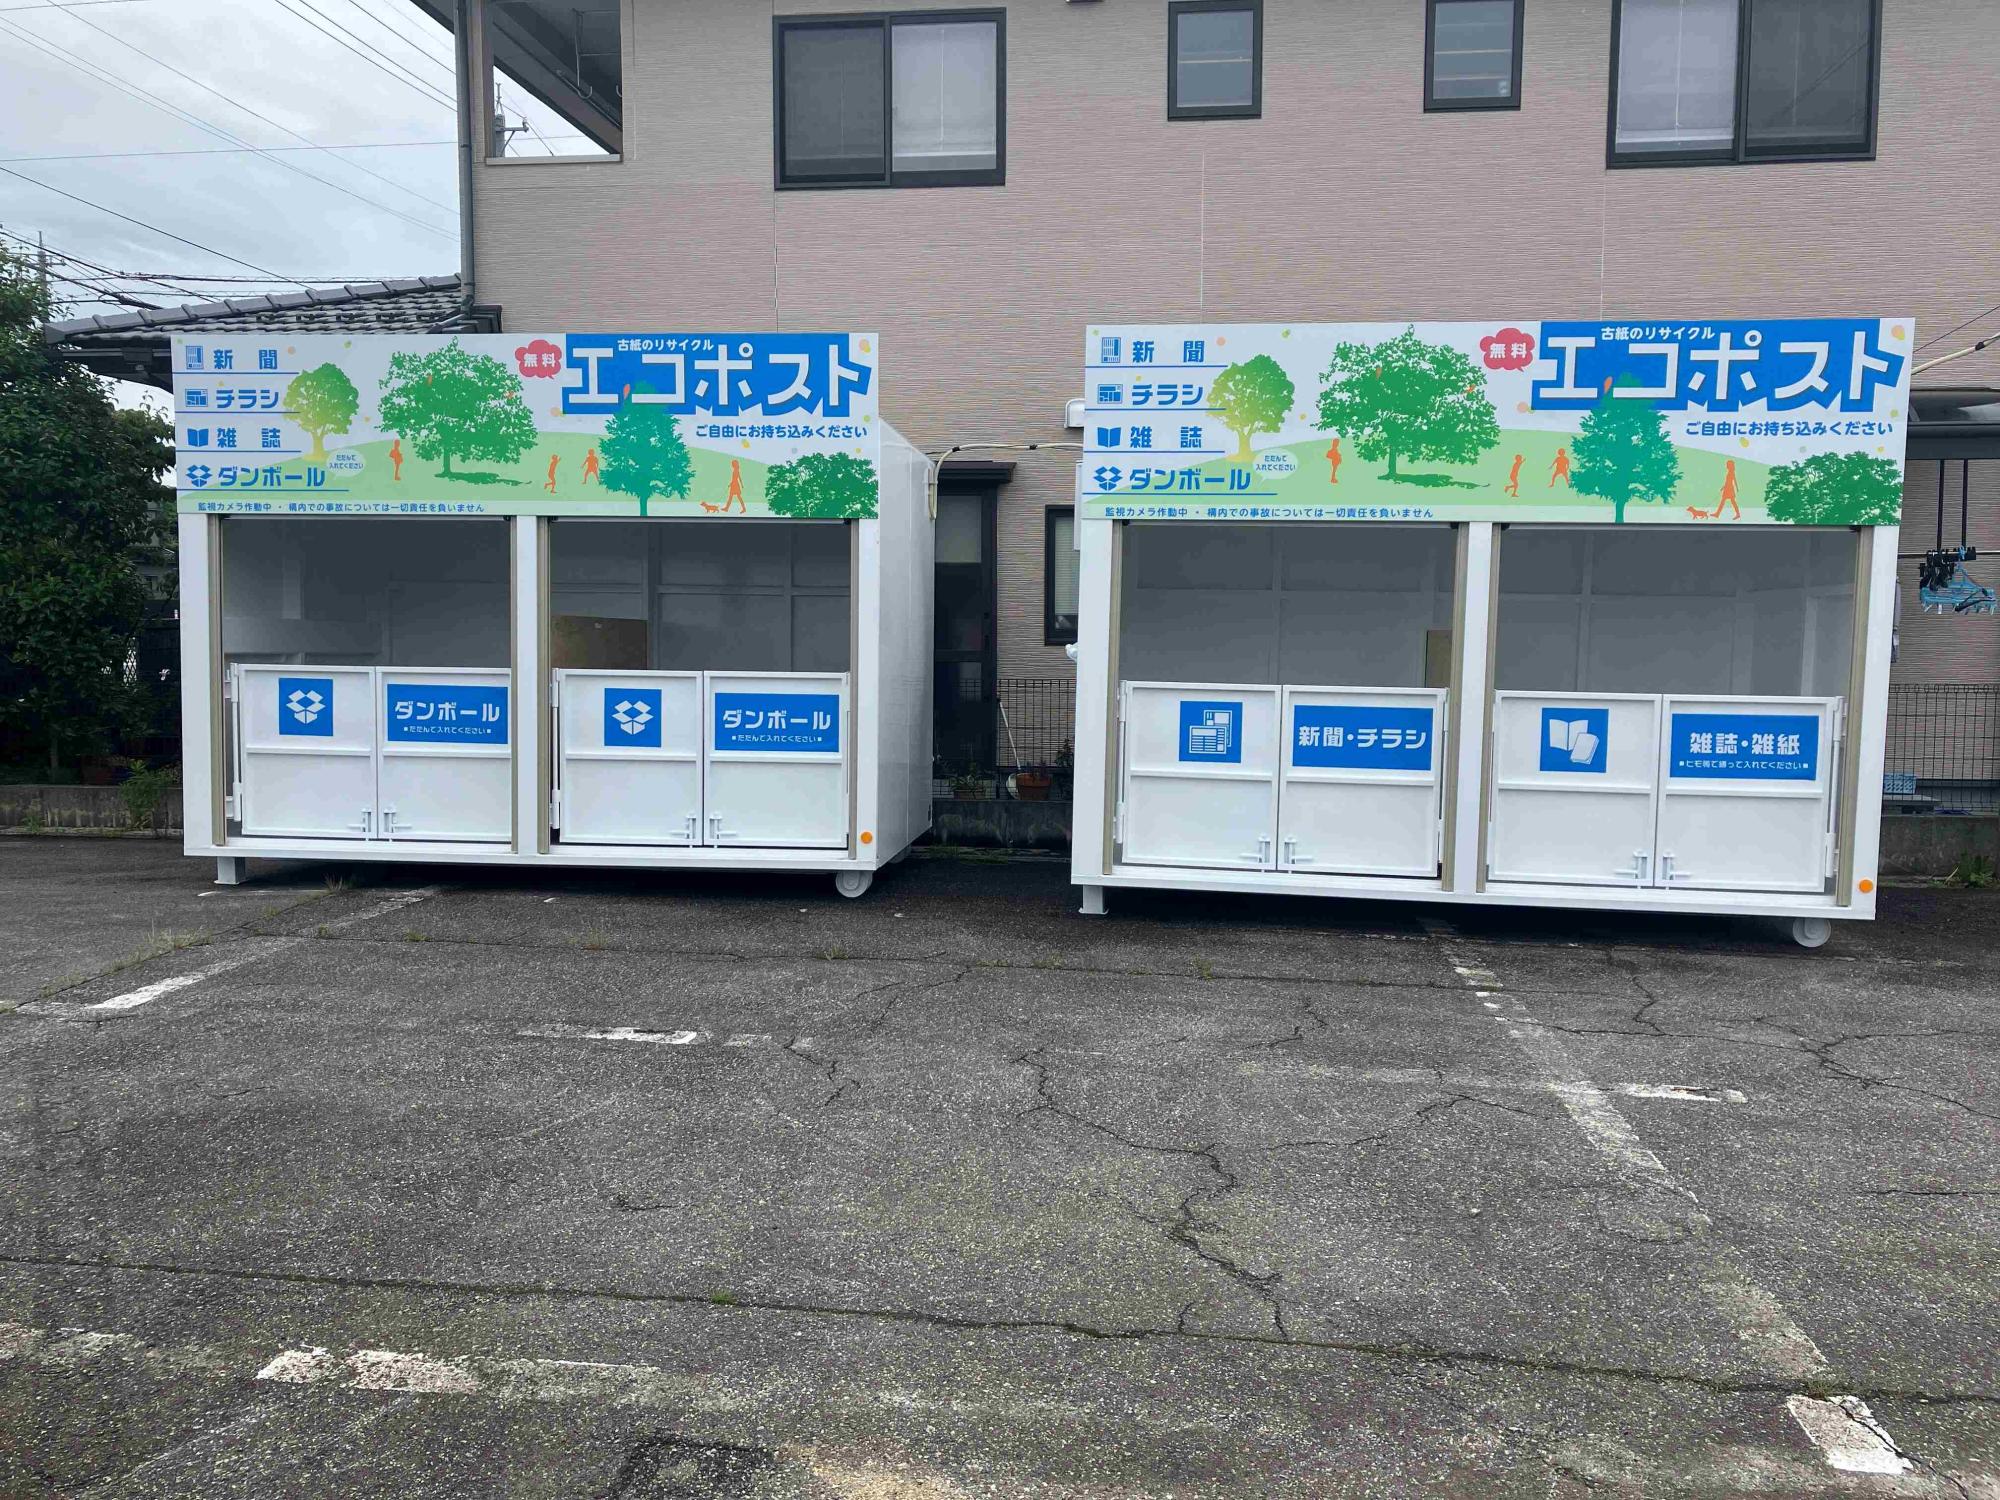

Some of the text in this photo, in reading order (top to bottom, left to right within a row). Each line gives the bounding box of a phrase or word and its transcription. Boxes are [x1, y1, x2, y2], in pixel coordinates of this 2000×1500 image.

[1601, 326, 1715, 341] 古紙のリサイクル
[617, 338, 714, 352] 古紙のリサイクル
[1133, 341, 1204, 363] 新聞
[1489, 342, 1528, 358] 無料
[214, 350, 277, 369] 新聞
[524, 353, 557, 368] 無料
[1539, 330, 1889, 400] エコポスト
[569, 343, 859, 406] エコポスト
[216, 390, 278, 408] チラシ
[1132, 384, 1203, 405] チラシ
[217, 428, 280, 448] 雑誌
[696, 424, 868, 439] ご自由にお持ち込みください
[1131, 426, 1202, 448] 雑誌
[1687, 421, 1892, 436] ご自由にお持ち込みください
[219, 467, 325, 487] ダンボール
[1130, 468, 1250, 490] ダンボール
[395, 701, 499, 721] ダンボール
[723, 710, 830, 729] ダンボール
